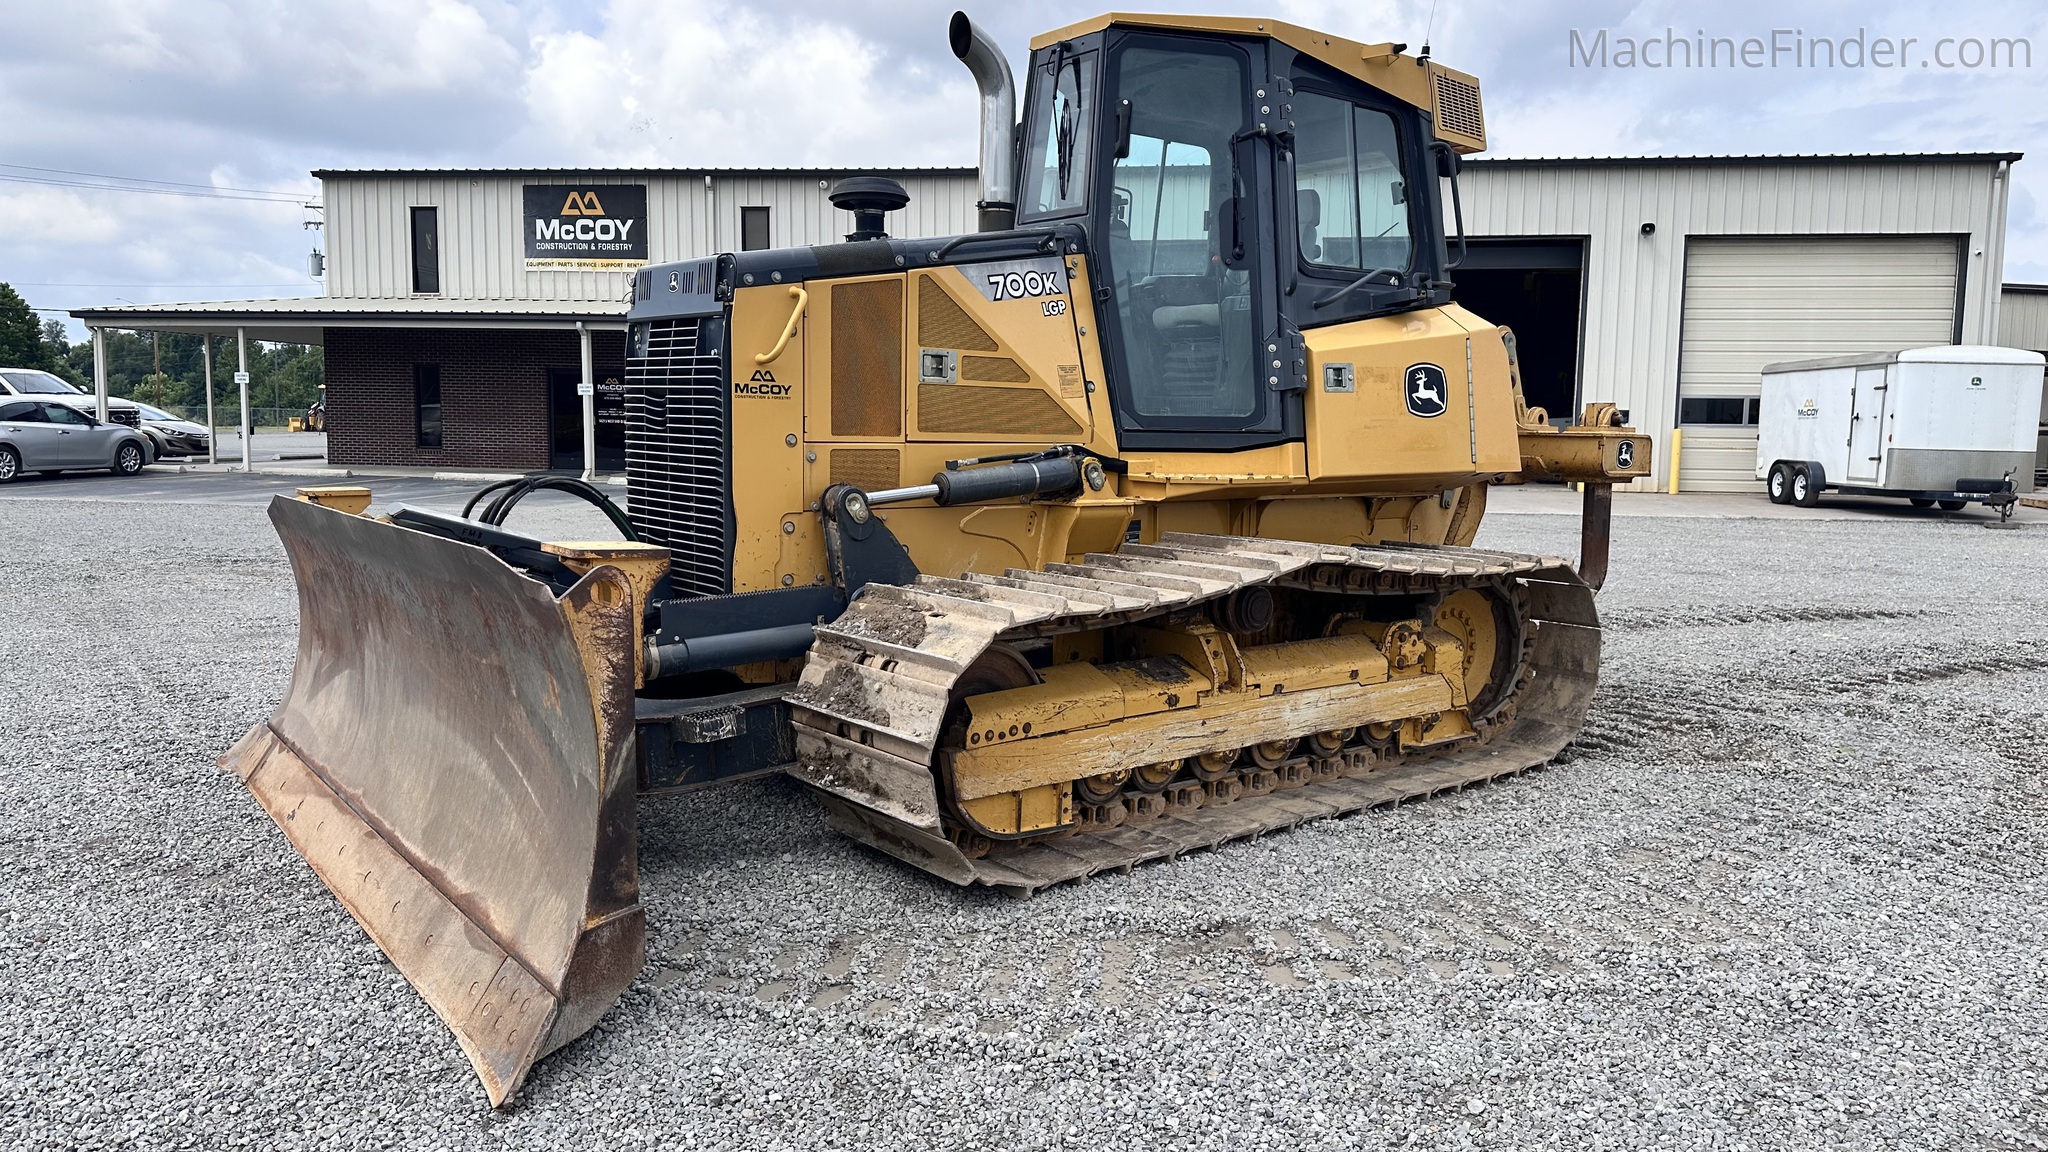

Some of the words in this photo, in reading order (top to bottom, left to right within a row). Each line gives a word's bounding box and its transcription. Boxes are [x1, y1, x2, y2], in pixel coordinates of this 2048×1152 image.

[535, 218, 634, 241] McCOY
[536, 242, 588, 250] CONSTRUCTION
[598, 243, 633, 251] FORESTRY
[987, 270, 1063, 301] 700K
[1041, 300, 1066, 317] LGP
[734, 382, 792, 395] McCOY
